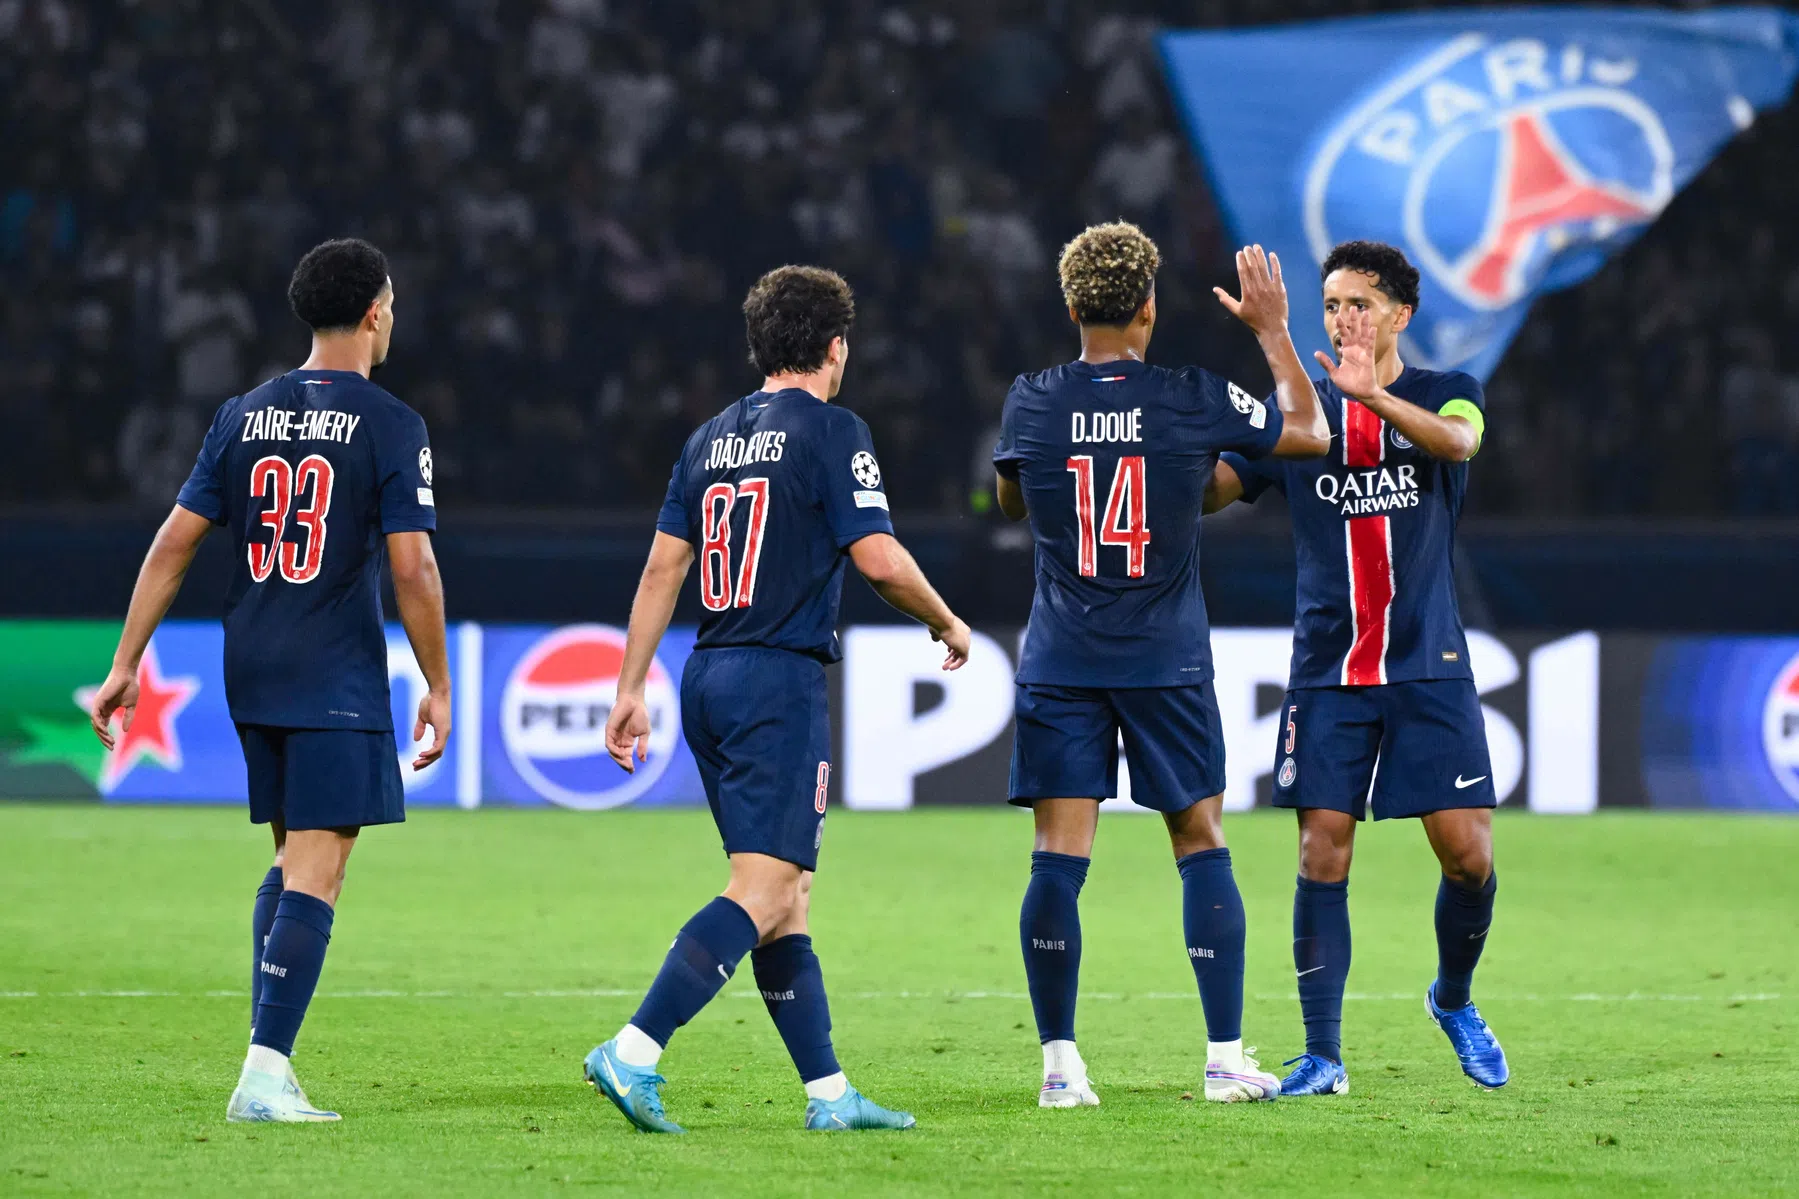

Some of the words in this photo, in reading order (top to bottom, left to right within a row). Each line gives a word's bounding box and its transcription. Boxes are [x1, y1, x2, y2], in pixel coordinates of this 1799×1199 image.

[242, 406, 360, 444] ZAÏRE-EMERY
[1071, 408, 1143, 443] D.DOUÉ
[1315, 464, 1419, 505] QATAR
[1340, 490, 1420, 515] AIRWAYS
[248, 454, 334, 584] 33
[1066, 455, 1151, 578] 14
[702, 477, 770, 612] 87
[1285, 705, 1297, 754] 5
[1032, 938, 1066, 951] PARIS
[1188, 947, 1215, 959] PARIS
[261, 960, 288, 978] PARIS
[762, 989, 796, 1001] PARIS
